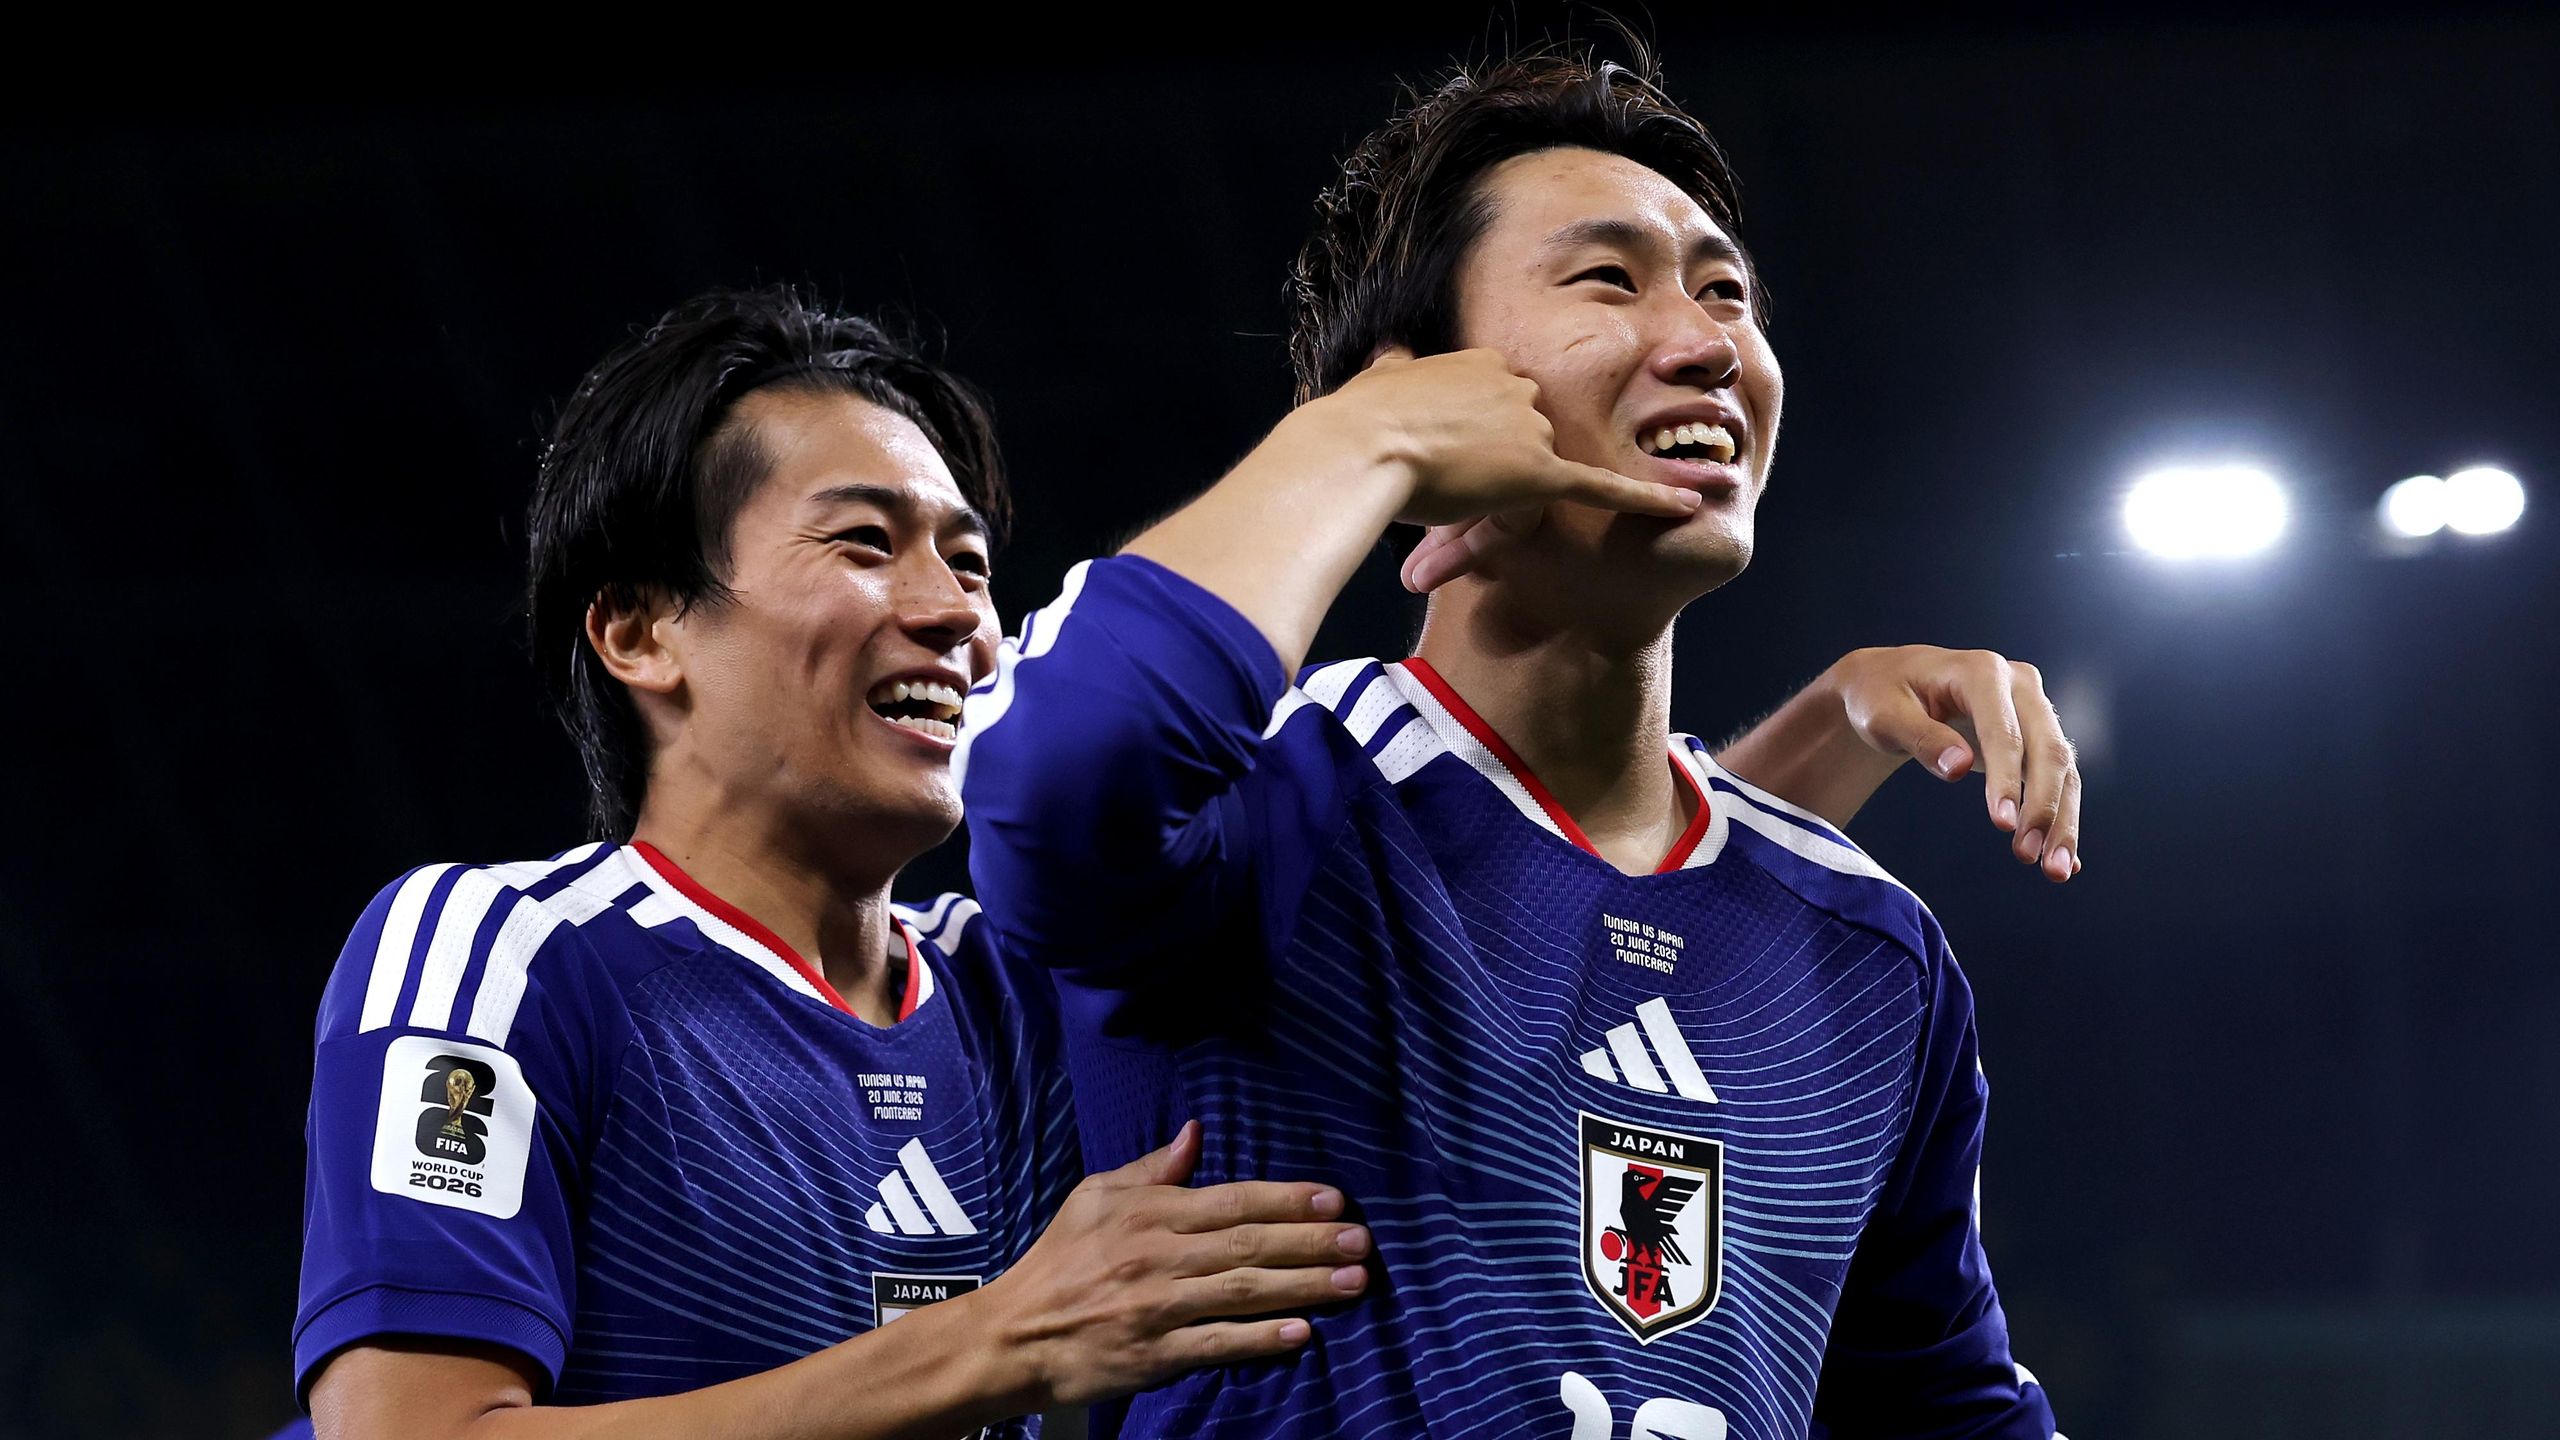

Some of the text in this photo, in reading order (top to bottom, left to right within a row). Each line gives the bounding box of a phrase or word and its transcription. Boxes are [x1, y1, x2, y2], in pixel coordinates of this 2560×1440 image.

[1603, 913, 1639, 934] TUNISIA
[1657, 929, 1684, 949] JAPAN
[1610, 932, 1677, 961] 20 JUNE 2026
[1616, 948, 1674, 975] MONTERREY
[857, 1073, 892, 1087] TUNISIA
[905, 1075, 927, 1089] JAPAN
[868, 1090, 923, 1105] 20 JUNE 2026
[874, 1106, 922, 1120] MONTERREY
[435, 1137, 468, 1156] FIFA
[1610, 1131, 1684, 1159] JAPAN
[412, 1160, 484, 1182] WORLD CUP
[409, 1172, 483, 1198] 2026
[893, 1284, 947, 1300] JAPAN
[1612, 1266, 1676, 1308] JFA
